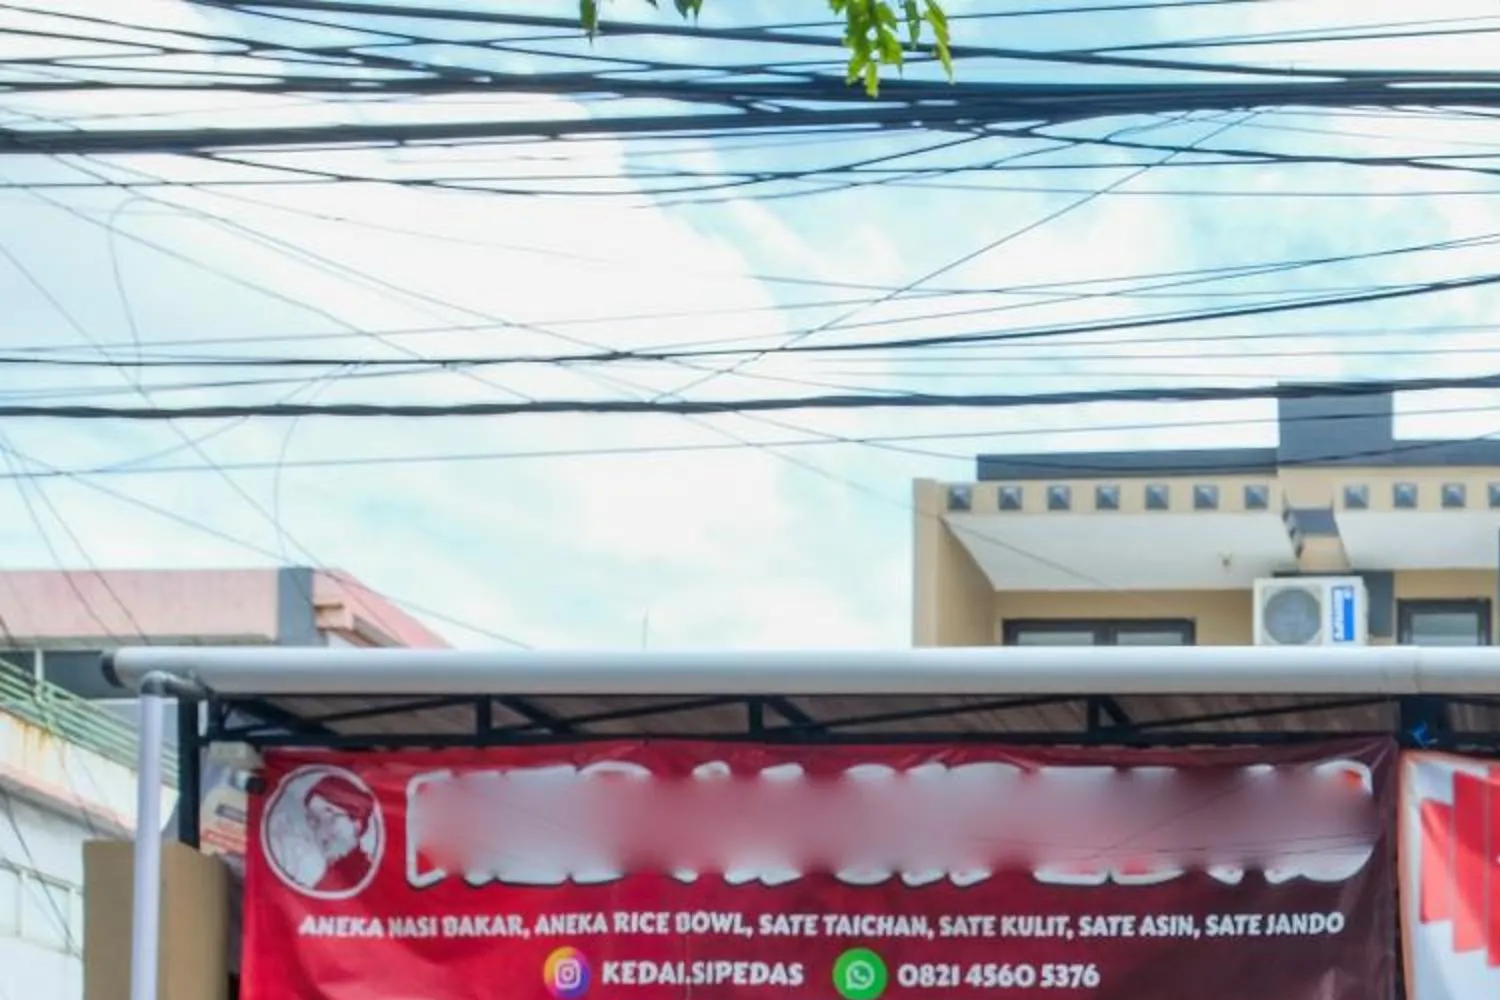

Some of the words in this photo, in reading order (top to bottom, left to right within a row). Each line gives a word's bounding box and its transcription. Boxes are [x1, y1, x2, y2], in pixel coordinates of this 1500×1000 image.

[300, 914, 384, 938] ANEKA
[388, 916, 437, 938] NASI
[441, 915, 531, 940] BAKAR,
[535, 913, 608, 936] ANEKA
[613, 912, 669, 934] RICE
[675, 911, 753, 938] BOWL,
[758, 914, 819, 936] SATE
[824, 914, 935, 940] TAICHAN,
[939, 915, 996, 937] SATE
[1000, 915, 1074, 940] KULIT,
[1078, 915, 1135, 937] SATE
[1140, 915, 1200, 940] ASIN,
[1205, 914, 1262, 936] SATE
[1265, 911, 1345, 936] JANDO
[602, 960, 805, 987] KEDAI.SIPEDAS
[898, 963, 960, 987] 0821
[965, 963, 1036, 987] 4560
[1039, 963, 1100, 987] 5376
